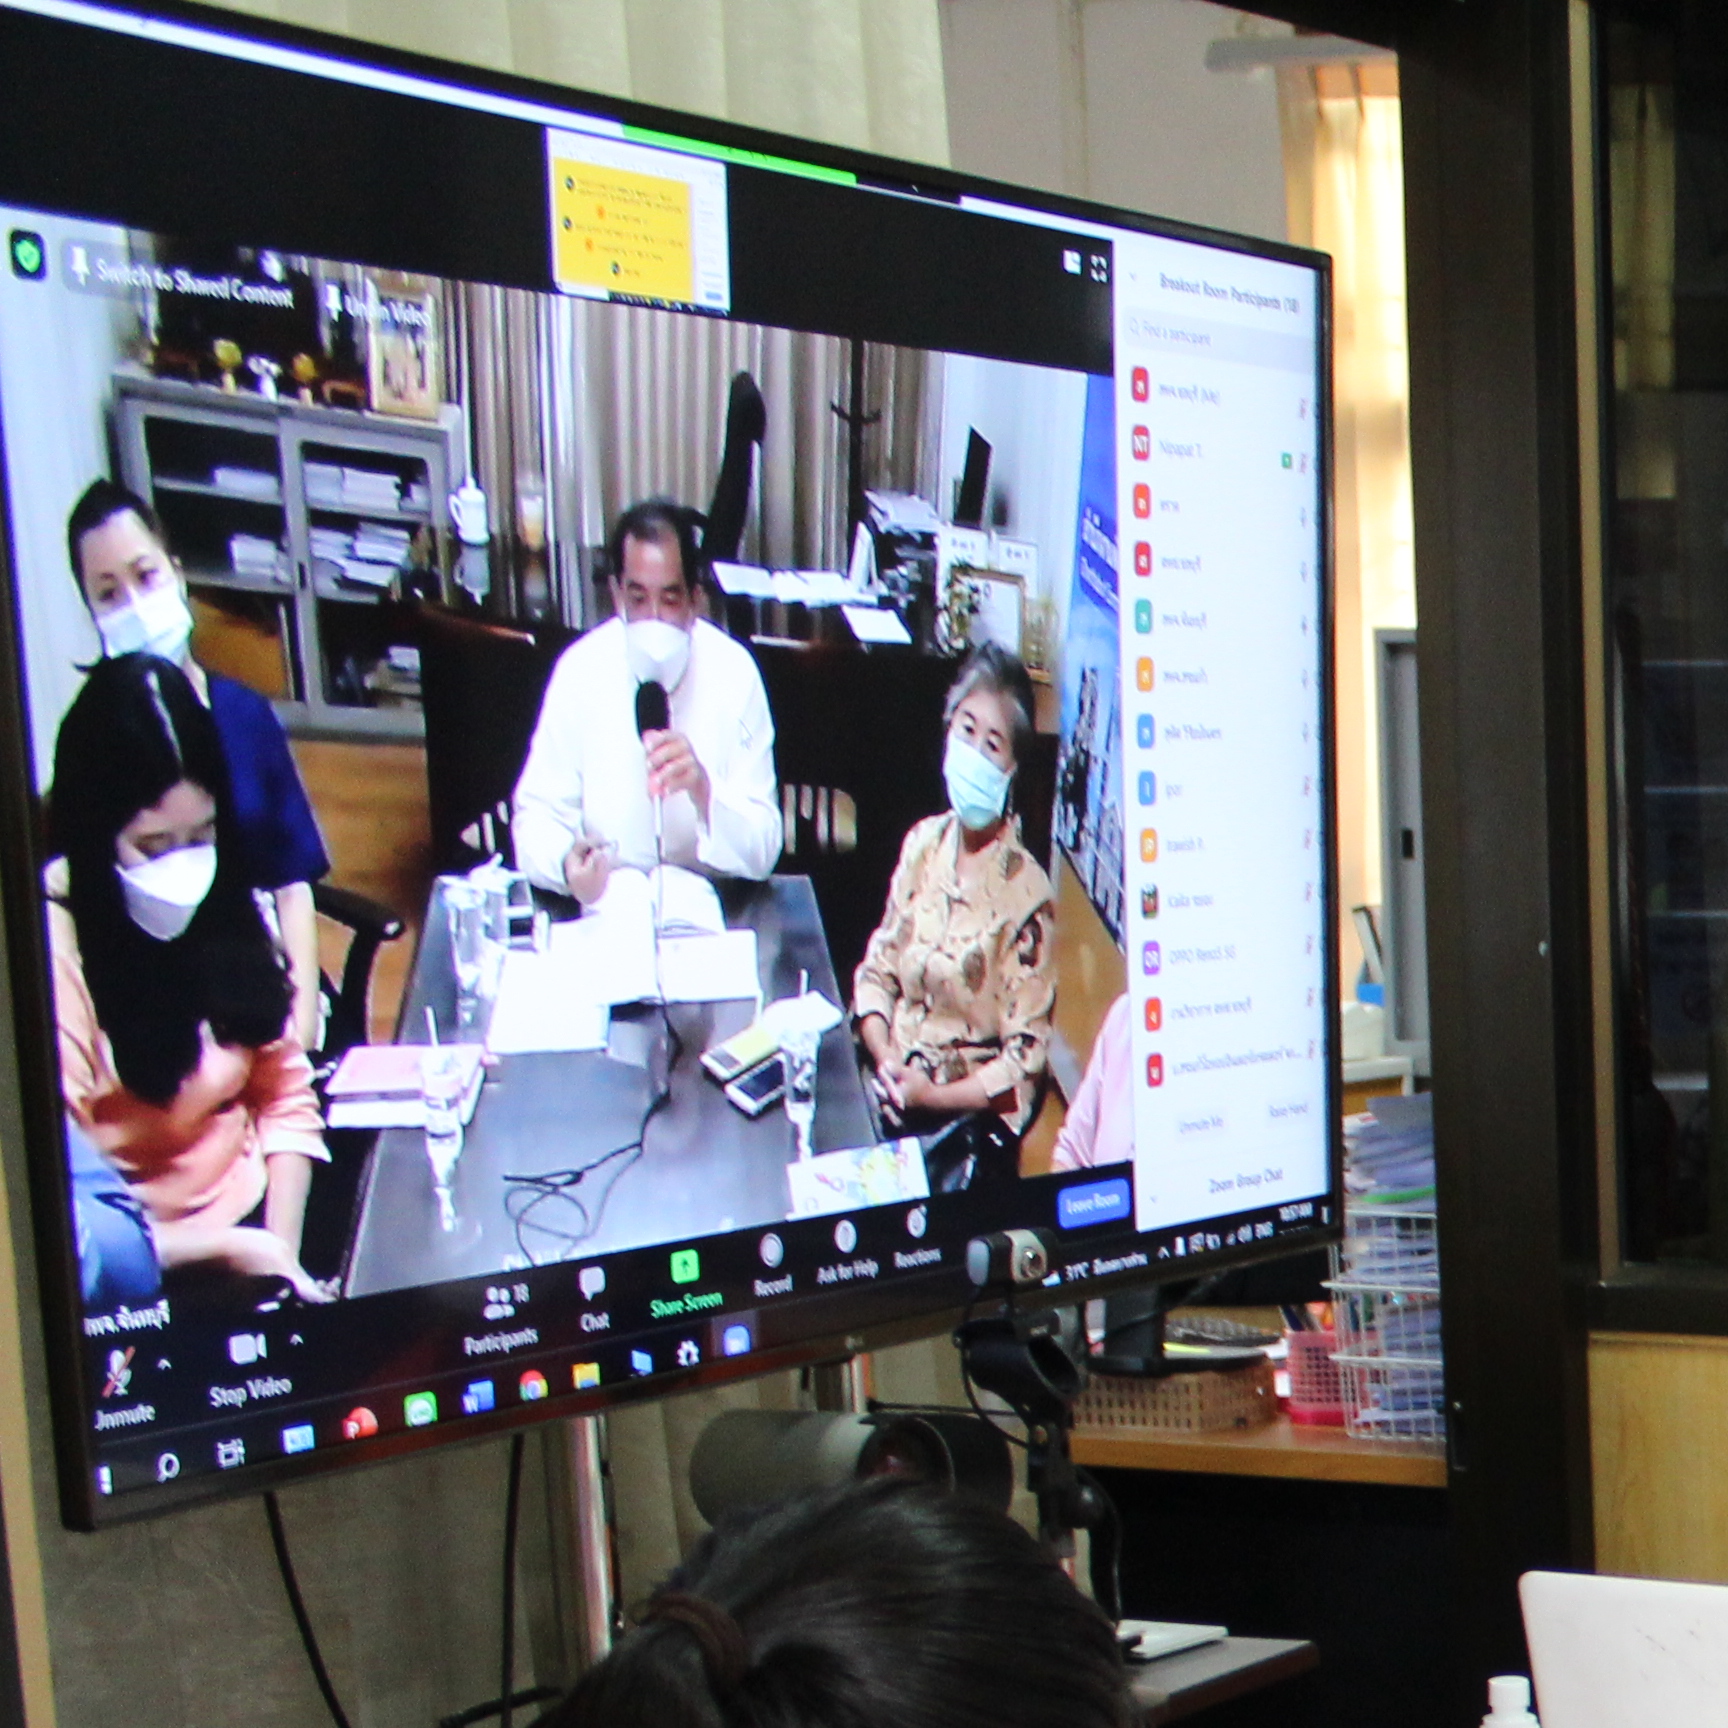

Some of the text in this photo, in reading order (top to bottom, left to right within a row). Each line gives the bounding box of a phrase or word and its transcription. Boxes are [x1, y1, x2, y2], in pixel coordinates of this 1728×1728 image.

[95, 257, 155, 288] Switch
[174, 268, 230, 300] Shared
[230, 278, 294, 308] Content
[1159, 272, 1201, 295] Breakout
[1202, 280, 1229, 299] Room
[1230, 286, 1282, 311] Participants
[817, 1265, 838, 1285] Ask
[853, 1258, 880, 1279] Help
[894, 1248, 942, 1269] Reactions
[754, 1273, 793, 1297] Record
[650, 1291, 724, 1320] Share Screen
[580, 1312, 611, 1333] Chat
[463, 1326, 540, 1357] Participants
[209, 1375, 293, 1409] Stop Video
